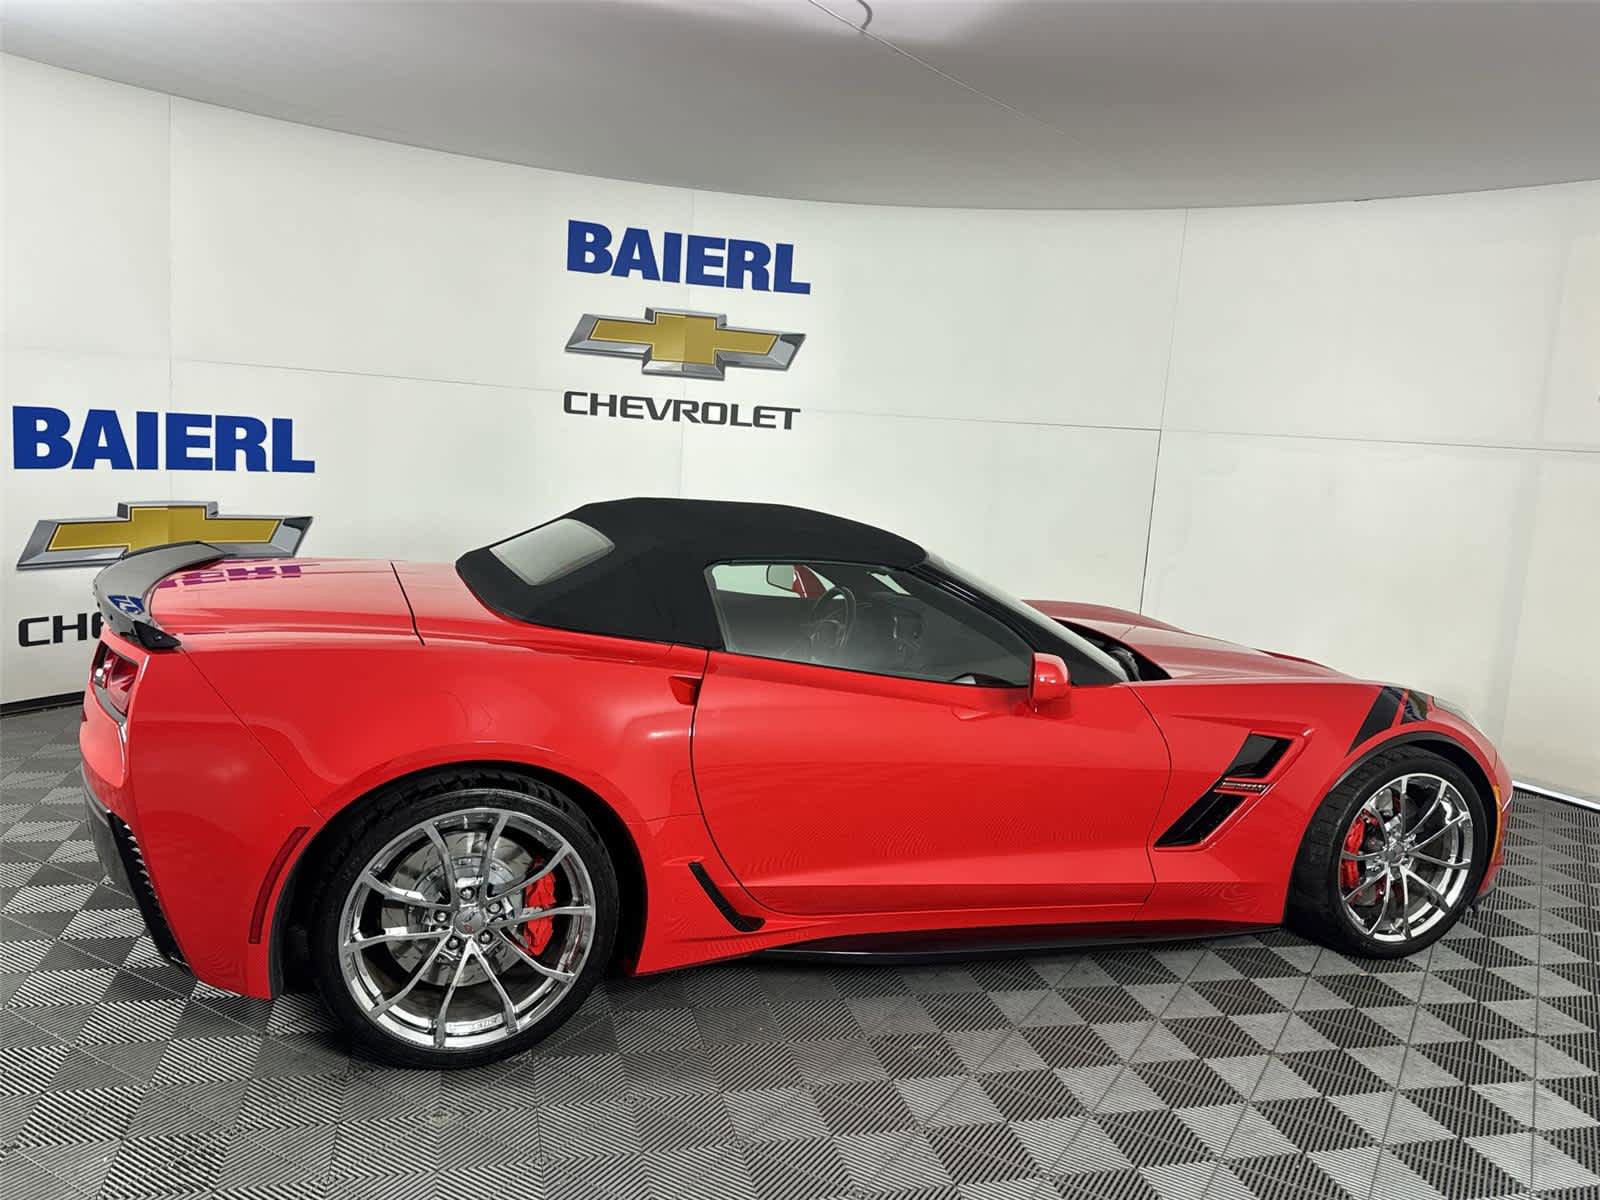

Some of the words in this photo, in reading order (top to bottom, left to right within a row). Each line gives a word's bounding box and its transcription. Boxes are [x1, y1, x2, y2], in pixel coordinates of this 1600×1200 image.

[567, 219, 811, 295] BAIERL
[12, 405, 315, 473] BAIERL
[563, 390, 801, 430] CHEVROLET
